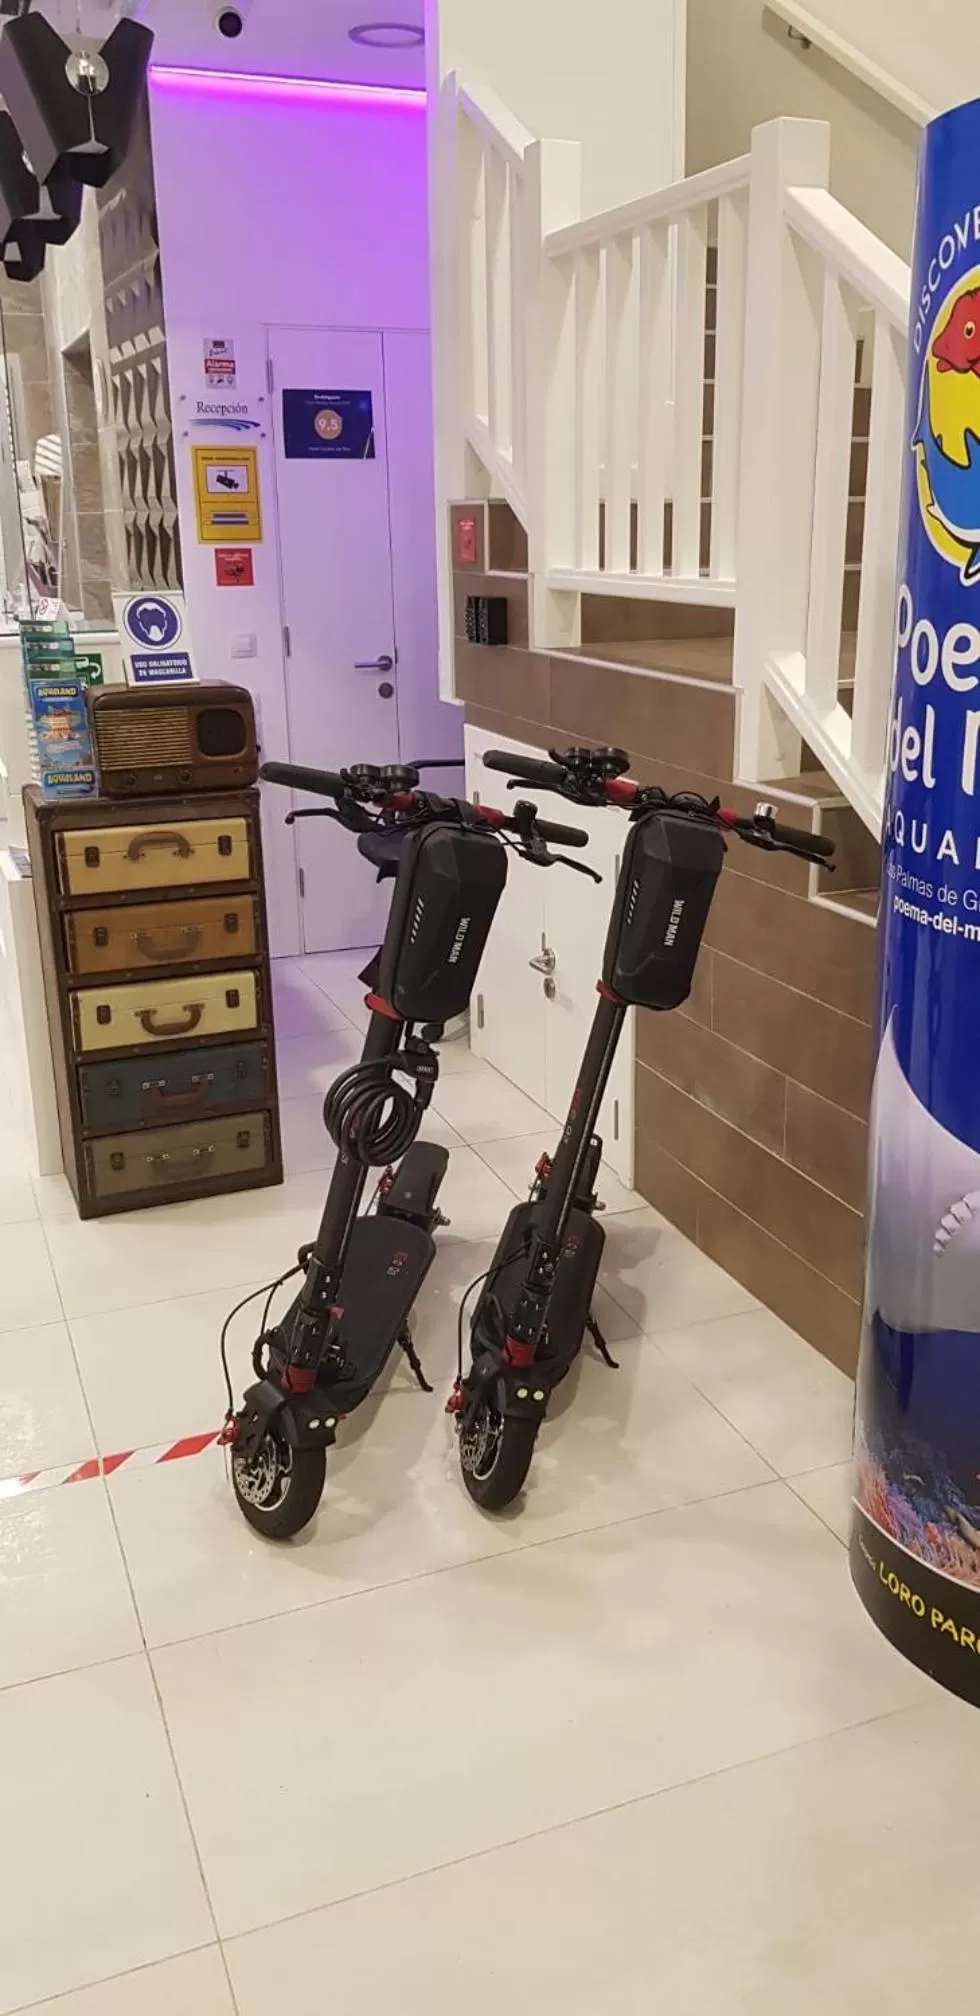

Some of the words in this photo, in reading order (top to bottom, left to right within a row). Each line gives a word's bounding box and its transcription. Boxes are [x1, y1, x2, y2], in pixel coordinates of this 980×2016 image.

[196, 401, 248, 416] Recepción
[47, 772, 93, 785] AQUALAND
[896, 864, 934, 899] Palmas
[937, 883, 958, 906] de
[671, 899, 686, 924] WILD
[455, 917, 471, 941] WILD
[663, 923, 679, 947] MAN
[448, 941, 463, 963] MAN
[879, 1560, 926, 1617] LORO
